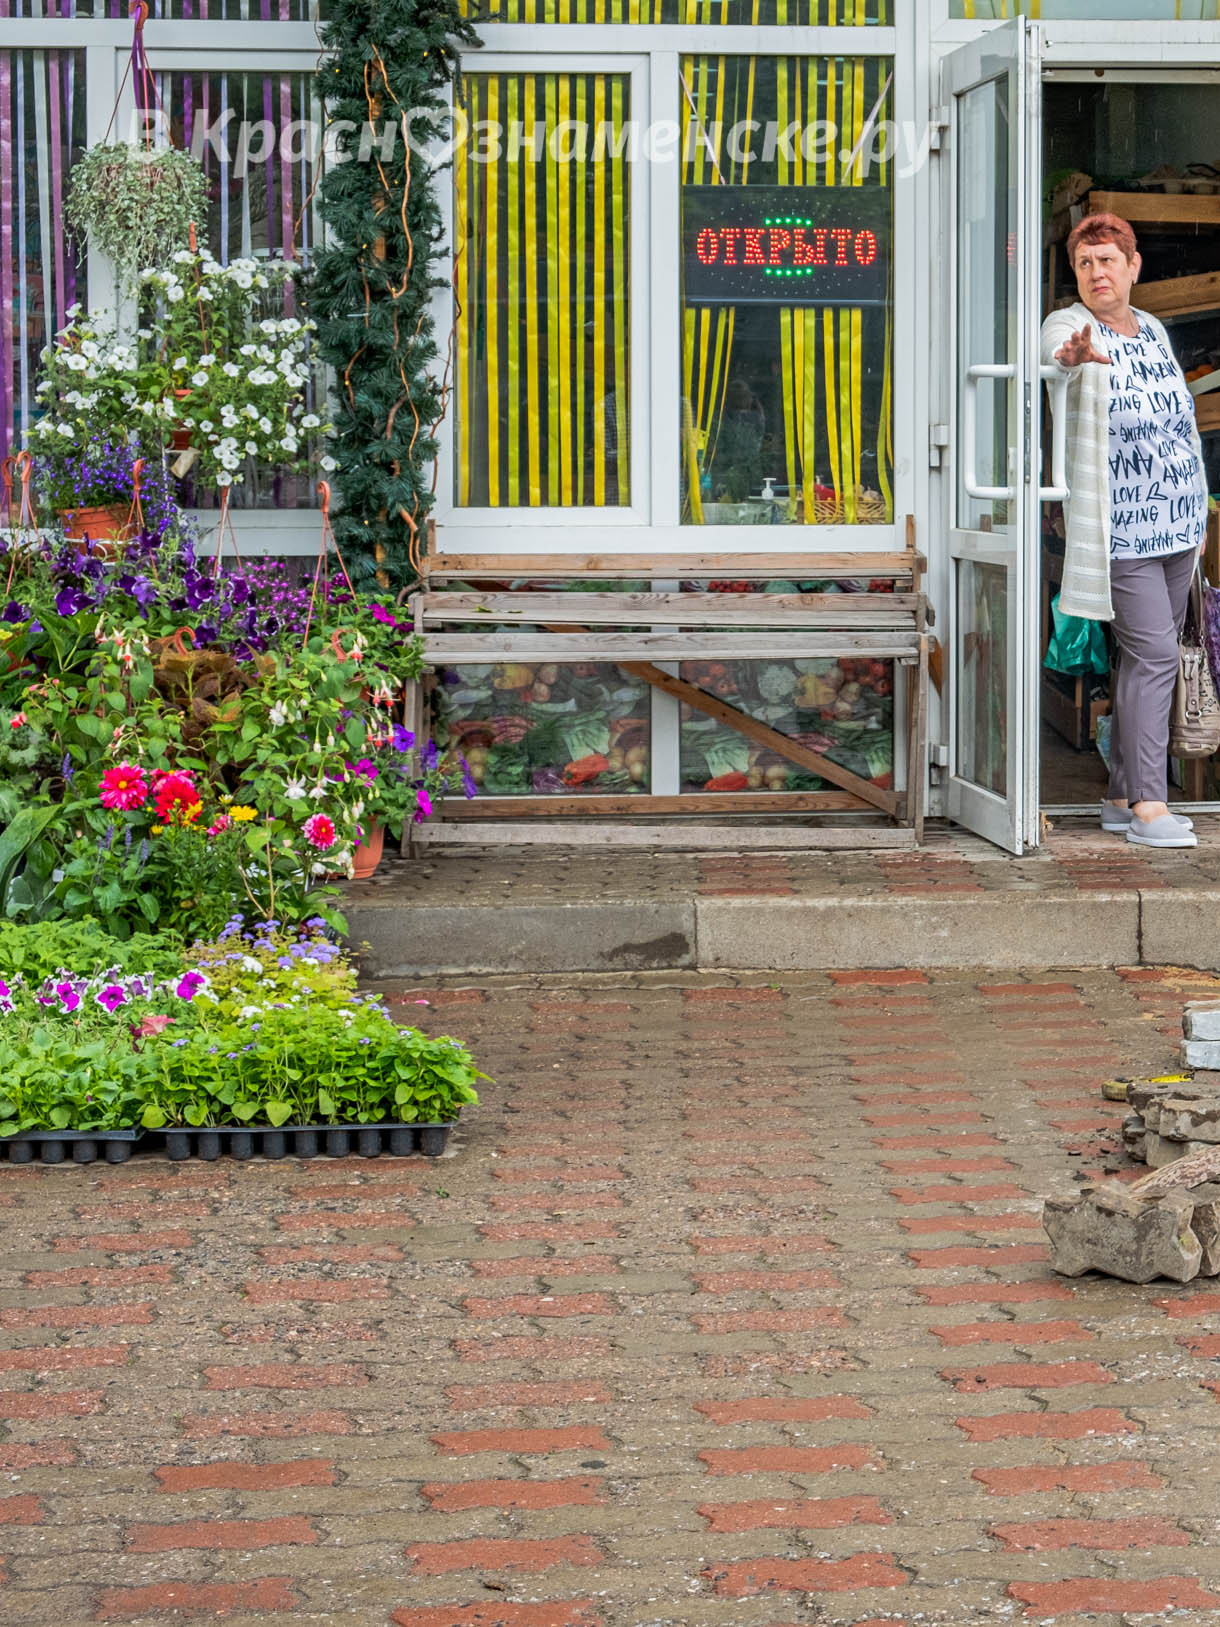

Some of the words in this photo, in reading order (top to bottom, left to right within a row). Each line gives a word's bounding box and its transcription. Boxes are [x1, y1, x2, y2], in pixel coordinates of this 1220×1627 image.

[696, 227, 878, 266] ОТКРЫТО
[1147, 390, 1182, 414] LOVE
[1113, 485, 1143, 505] LOVE
[1170, 493, 1197, 524] LOVE
[1134, 529, 1174, 554] AMAZING
